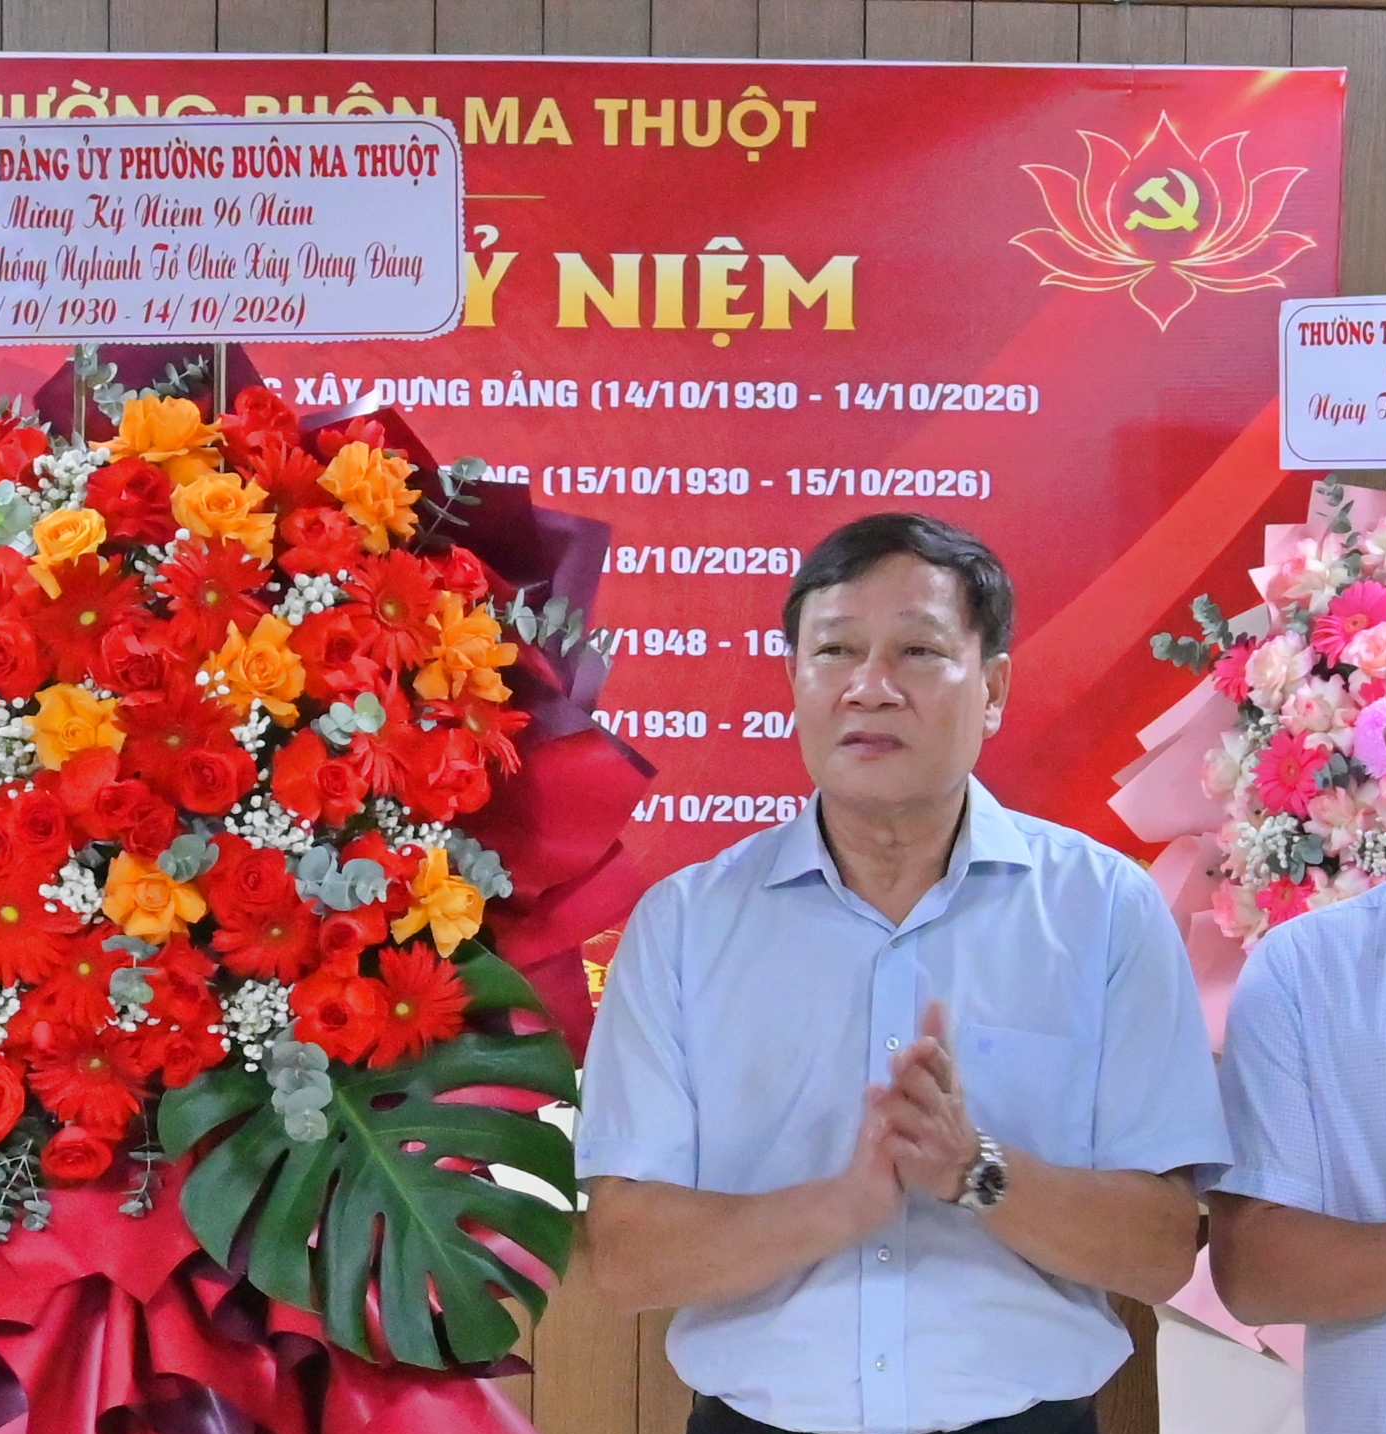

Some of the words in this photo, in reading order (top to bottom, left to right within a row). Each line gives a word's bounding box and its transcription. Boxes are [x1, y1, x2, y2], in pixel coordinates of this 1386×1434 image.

[465, 96, 573, 145] MA
[595, 85, 817, 161] THUỘT
[77, 134, 112, 181] ỦY
[119, 136, 224, 180] PHƯỜNG
[231, 135, 302, 179] BUÔN
[309, 144, 348, 178] MA
[354, 134, 440, 186] THUỘT
[1, 194, 76, 237] Mừng
[83, 193, 126, 235] Kỷ
[134, 193, 204, 235] Niệm
[214, 195, 242, 229] 96
[250, 191, 315, 227] Năm
[55, 244, 142, 290] Nghành
[150, 242, 181, 281] Tổ
[188, 242, 236, 281] Chức
[244, 242, 291, 287] Xây
[297, 241, 358, 287] Dựng
[364, 241, 425, 286] Đảng
[462, 224, 518, 328] Ỷ
[555, 236, 858, 348] NIỆM
[1298, 314, 1375, 346] THƯỜNG
[294, 372, 362, 405] XÂY
[374, 375, 469, 412] DỰNG
[481, 370, 577, 406] ĐẢNG
[591, 379, 797, 411] (14/10/1930
[835, 381, 1039, 414] 14/10/2026)
[1308, 392, 1367, 427] Ngày
[543, 466, 749, 496] (15/10/1930
[786, 468, 990, 499] 15/10/2026)
